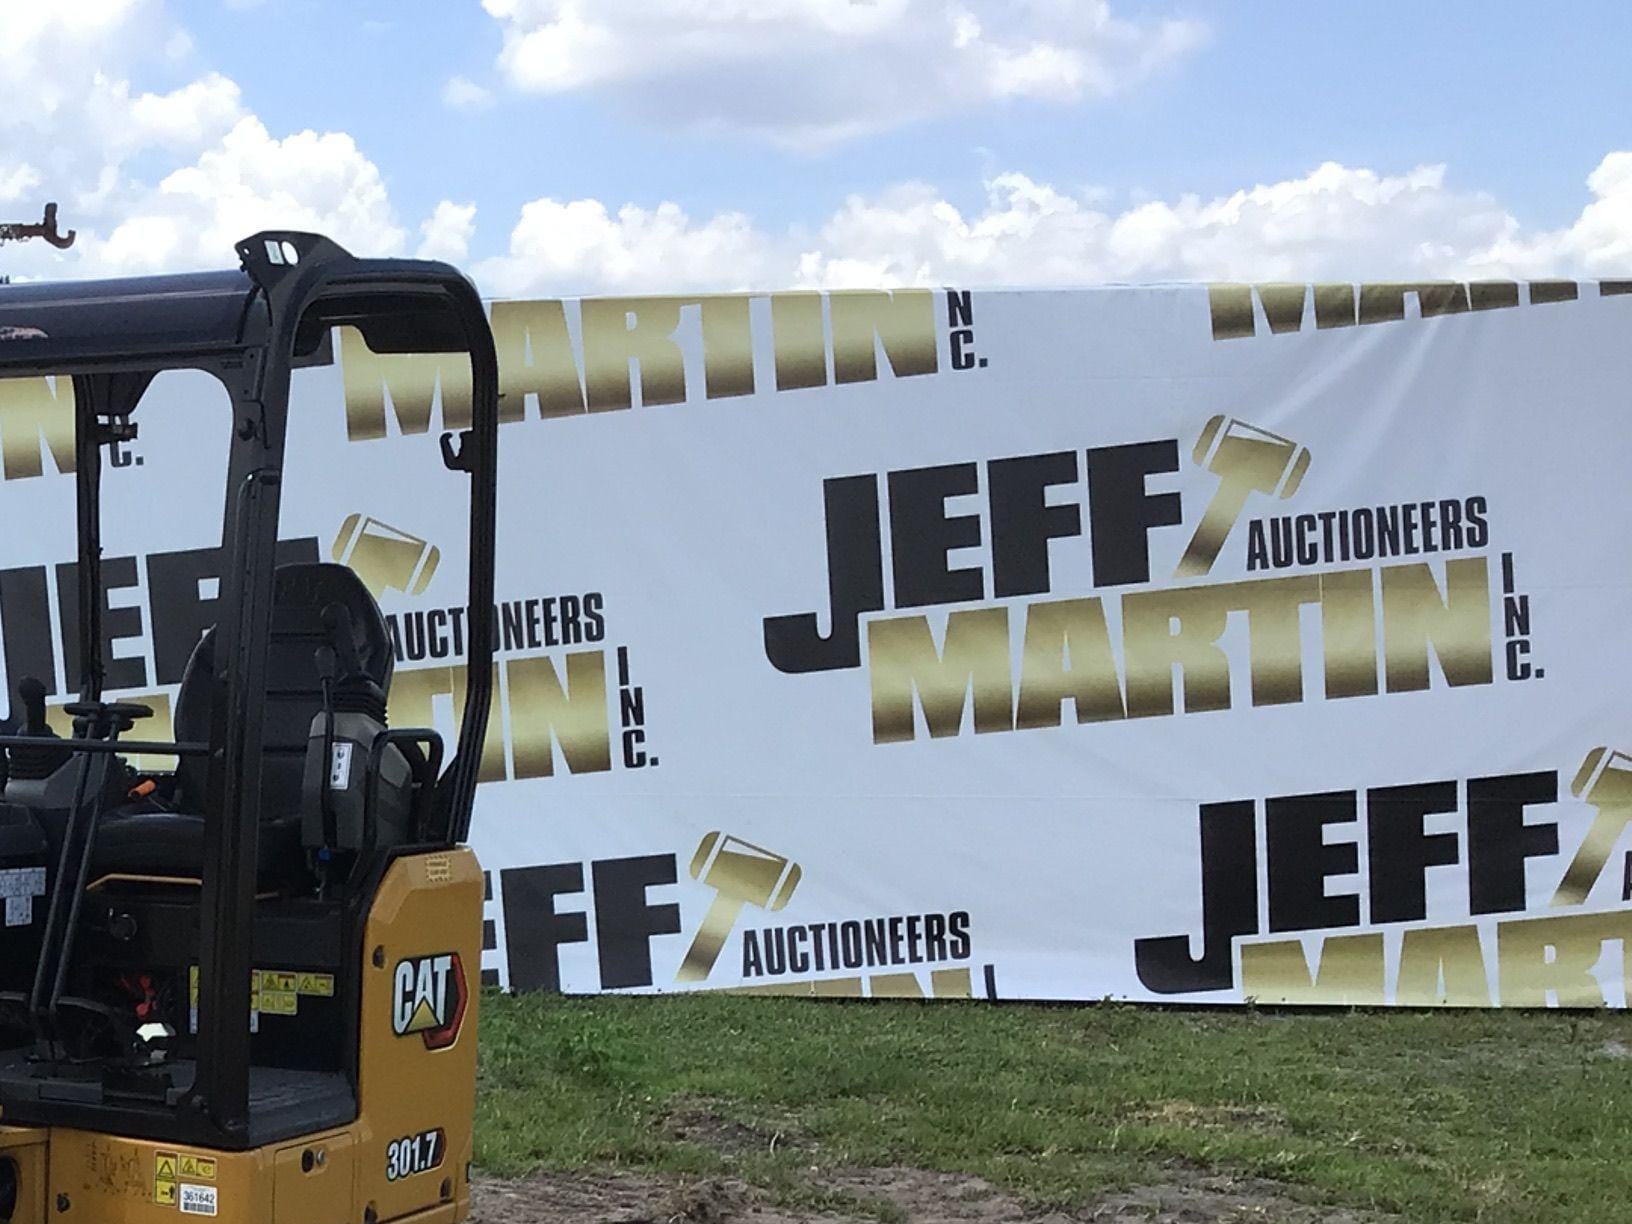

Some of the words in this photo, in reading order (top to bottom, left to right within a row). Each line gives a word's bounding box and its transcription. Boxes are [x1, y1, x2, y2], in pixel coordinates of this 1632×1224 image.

[763, 439, 1182, 674] JEFF
[1246, 496, 1489, 571] AUCTIONEERS
[868, 556, 1494, 745] MARTIN
[1134, 770, 1560, 994] JEFF
[742, 911, 971, 978] AUCTIONEERS
[393, 955, 452, 1035] CAT
[387, 1130, 438, 1181] 301.7
